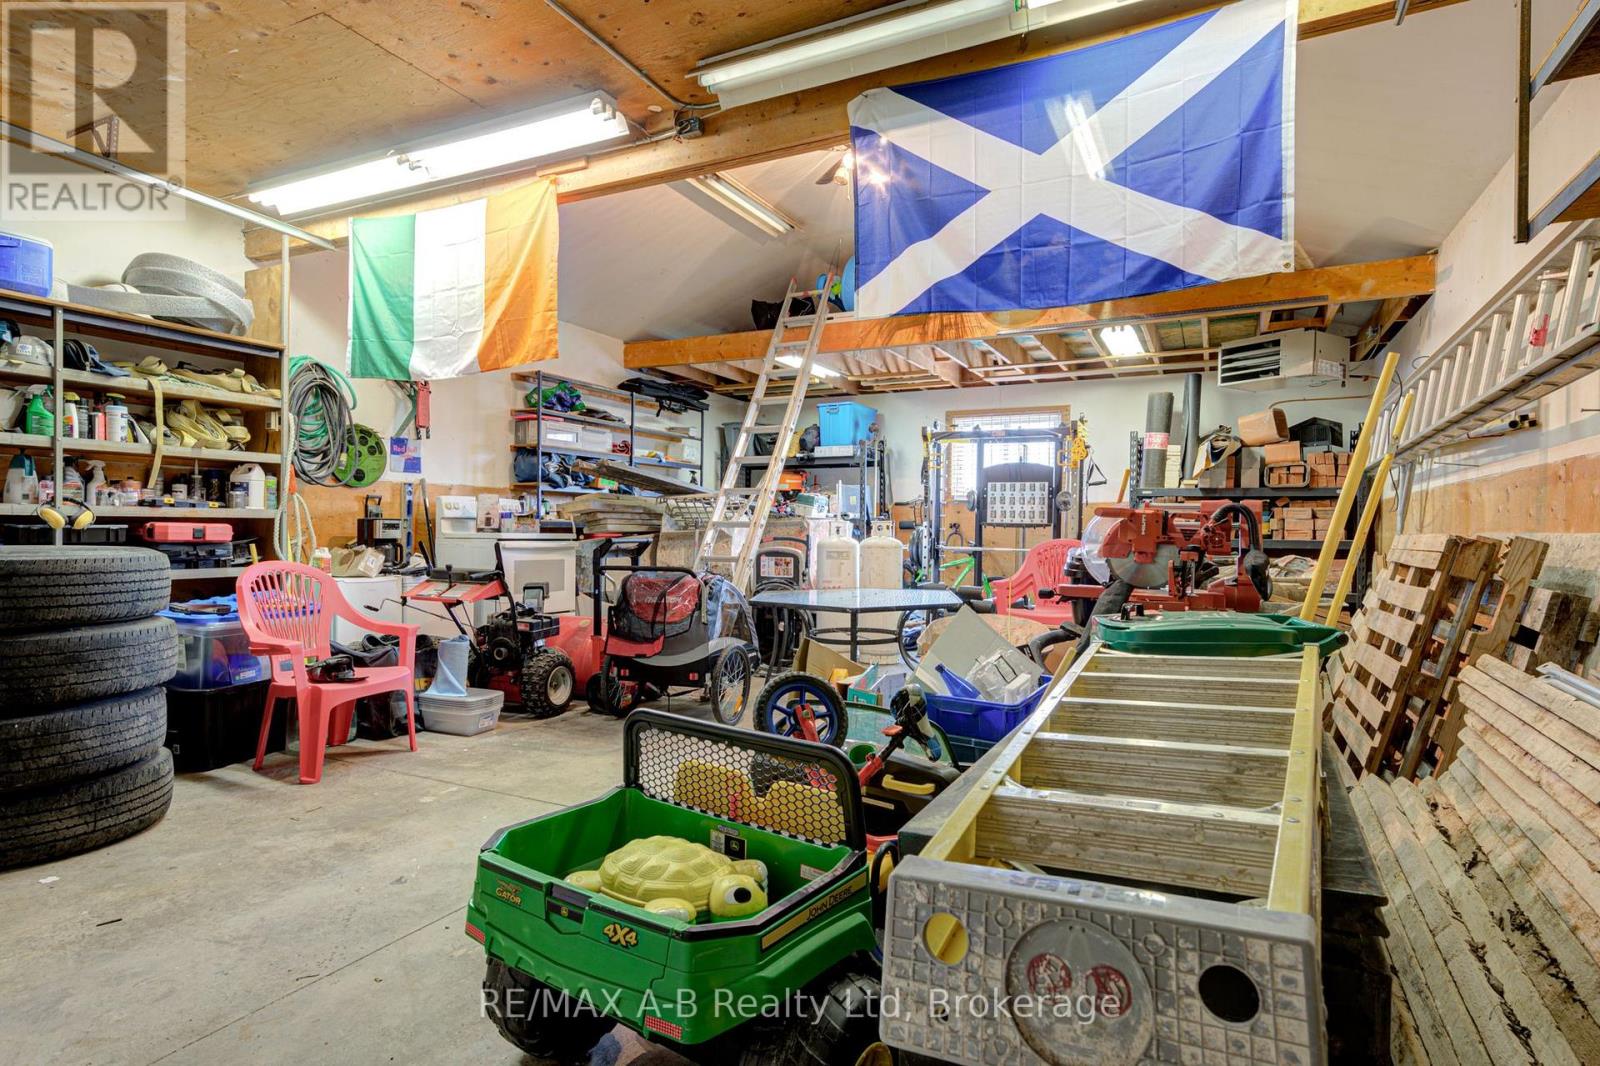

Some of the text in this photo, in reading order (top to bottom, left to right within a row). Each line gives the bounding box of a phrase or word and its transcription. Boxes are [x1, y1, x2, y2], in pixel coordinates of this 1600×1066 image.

[495, 887, 522, 906] GATOR
[808, 886, 853, 921] JOHN DEERE
